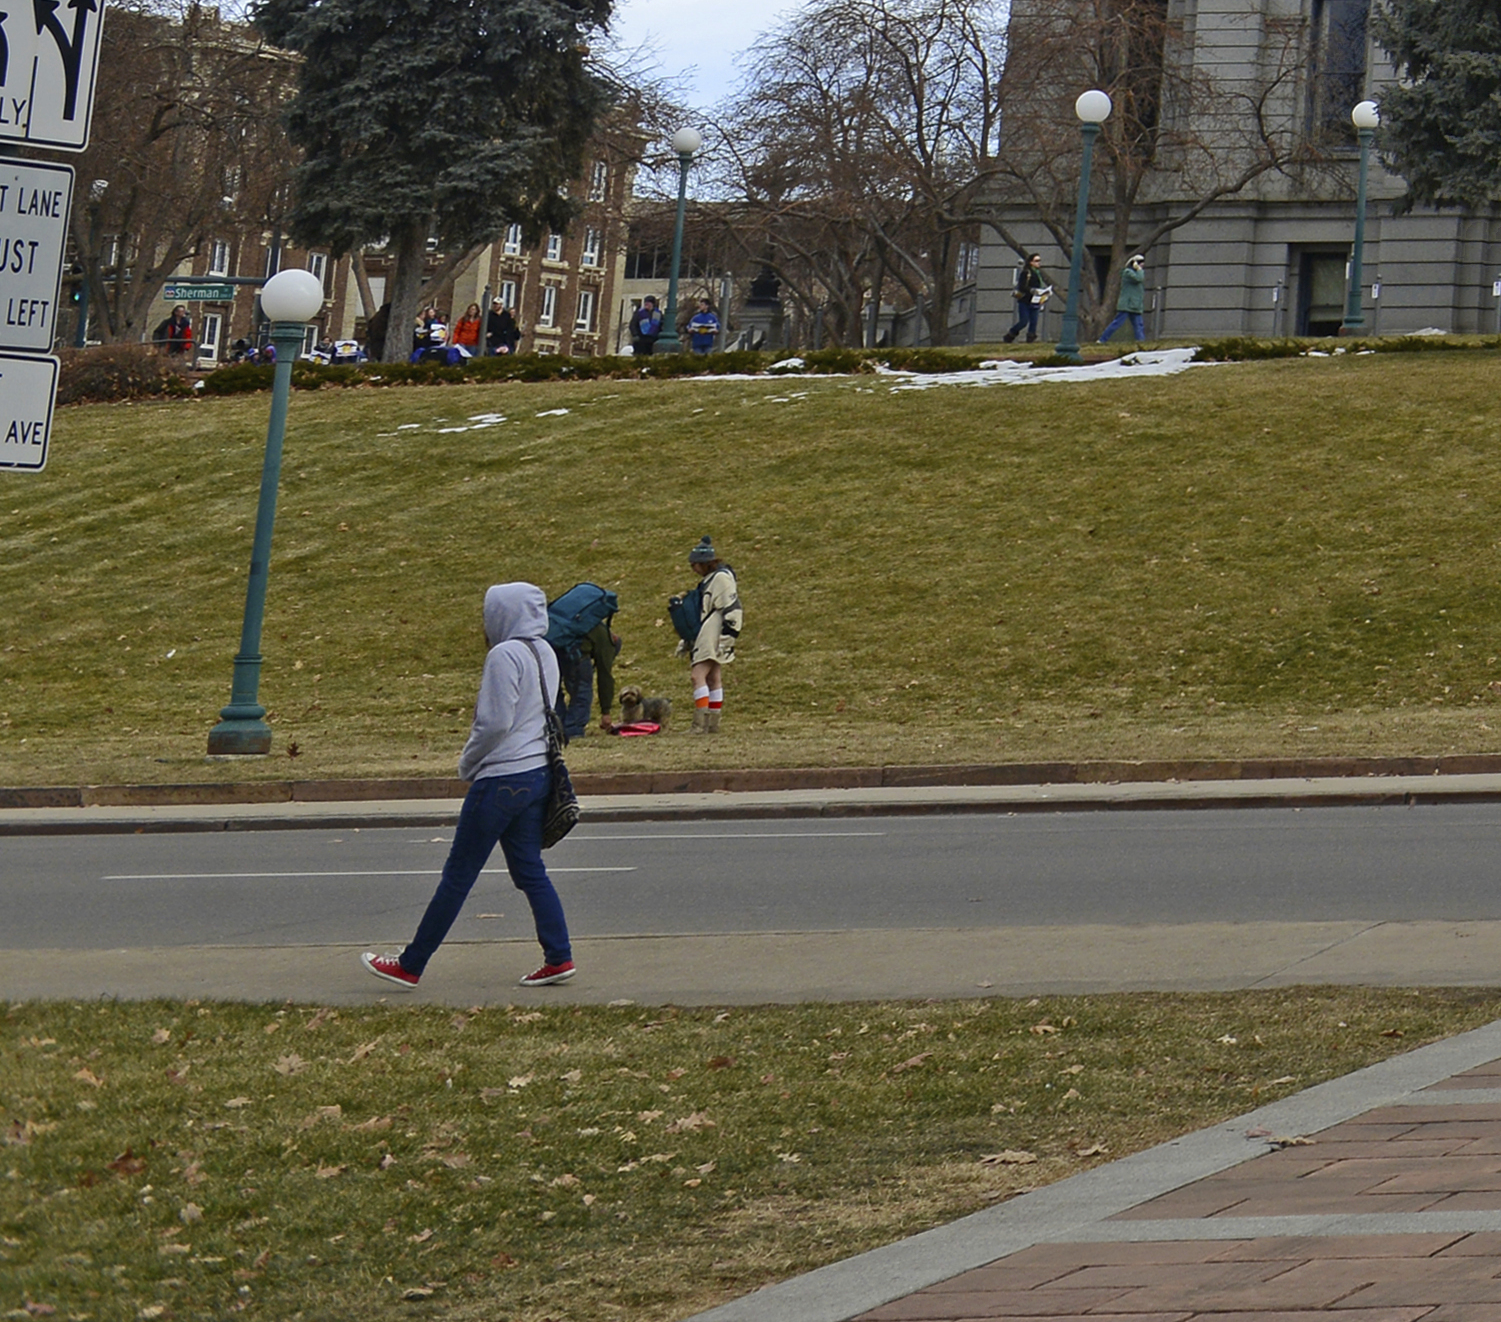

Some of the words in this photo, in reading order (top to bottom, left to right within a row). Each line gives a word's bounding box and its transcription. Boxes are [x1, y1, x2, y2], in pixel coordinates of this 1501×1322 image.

[18, 187, 62, 218] LANE
[175, 288, 219, 298] Sherman
[7, 298, 49, 328] LEFT
[5, 420, 44, 445] AVE
